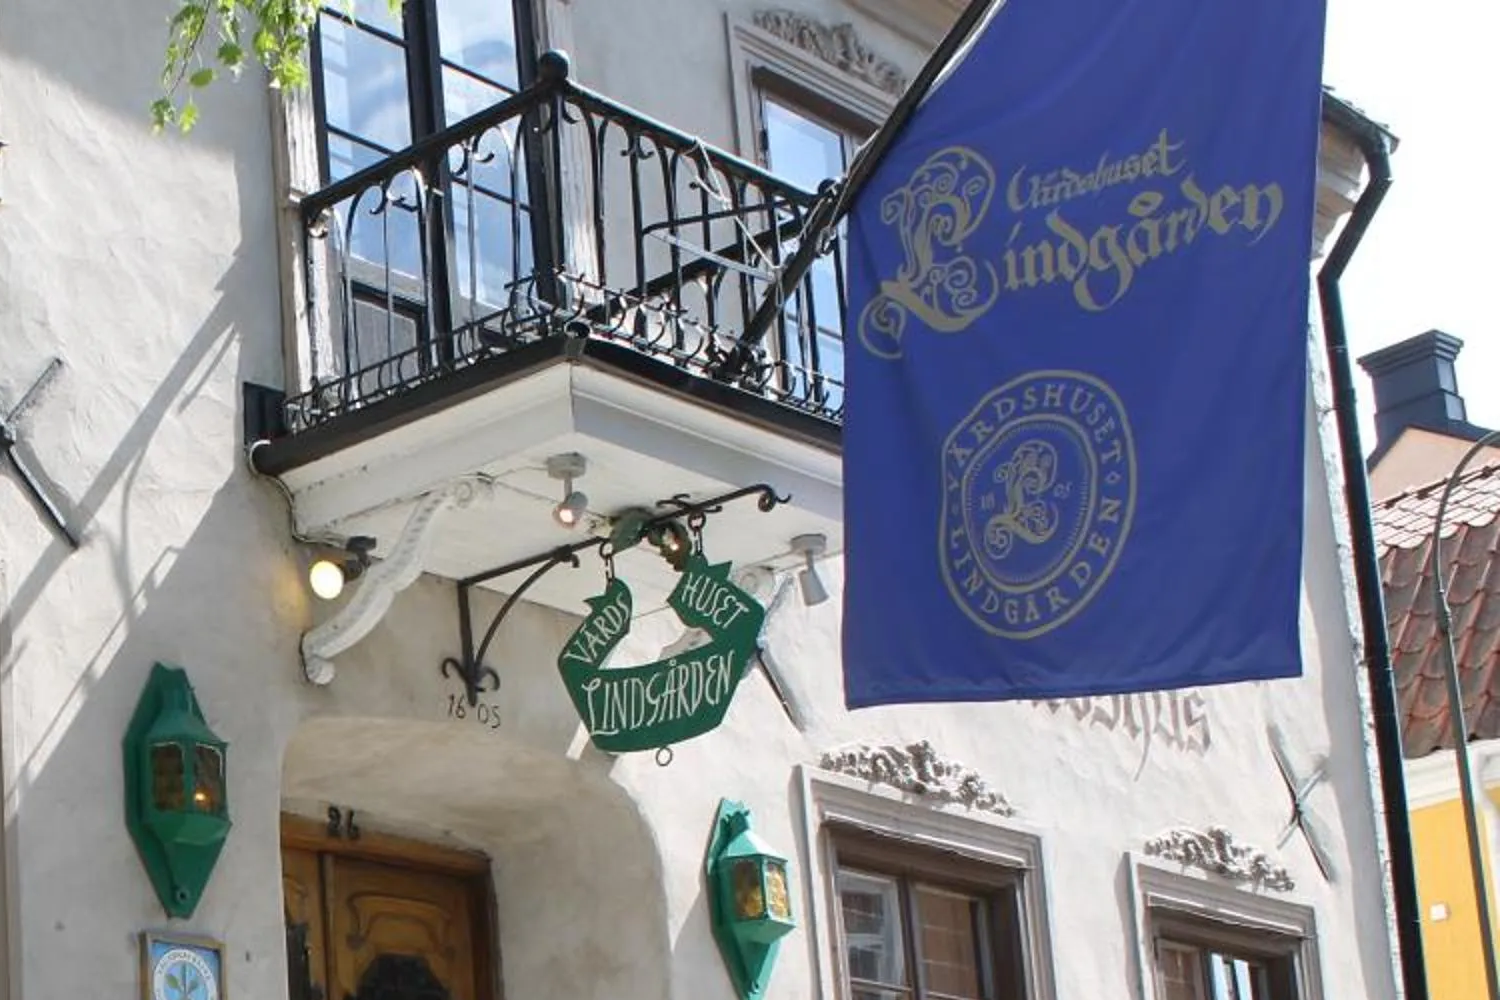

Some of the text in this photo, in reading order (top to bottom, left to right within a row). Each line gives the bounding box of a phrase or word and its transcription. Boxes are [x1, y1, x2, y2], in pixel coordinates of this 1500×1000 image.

[858, 146, 1284, 360] Lindgården
[681, 572, 750, 629] HUSET
[581, 649, 735, 736] LINDGÅRDEN
